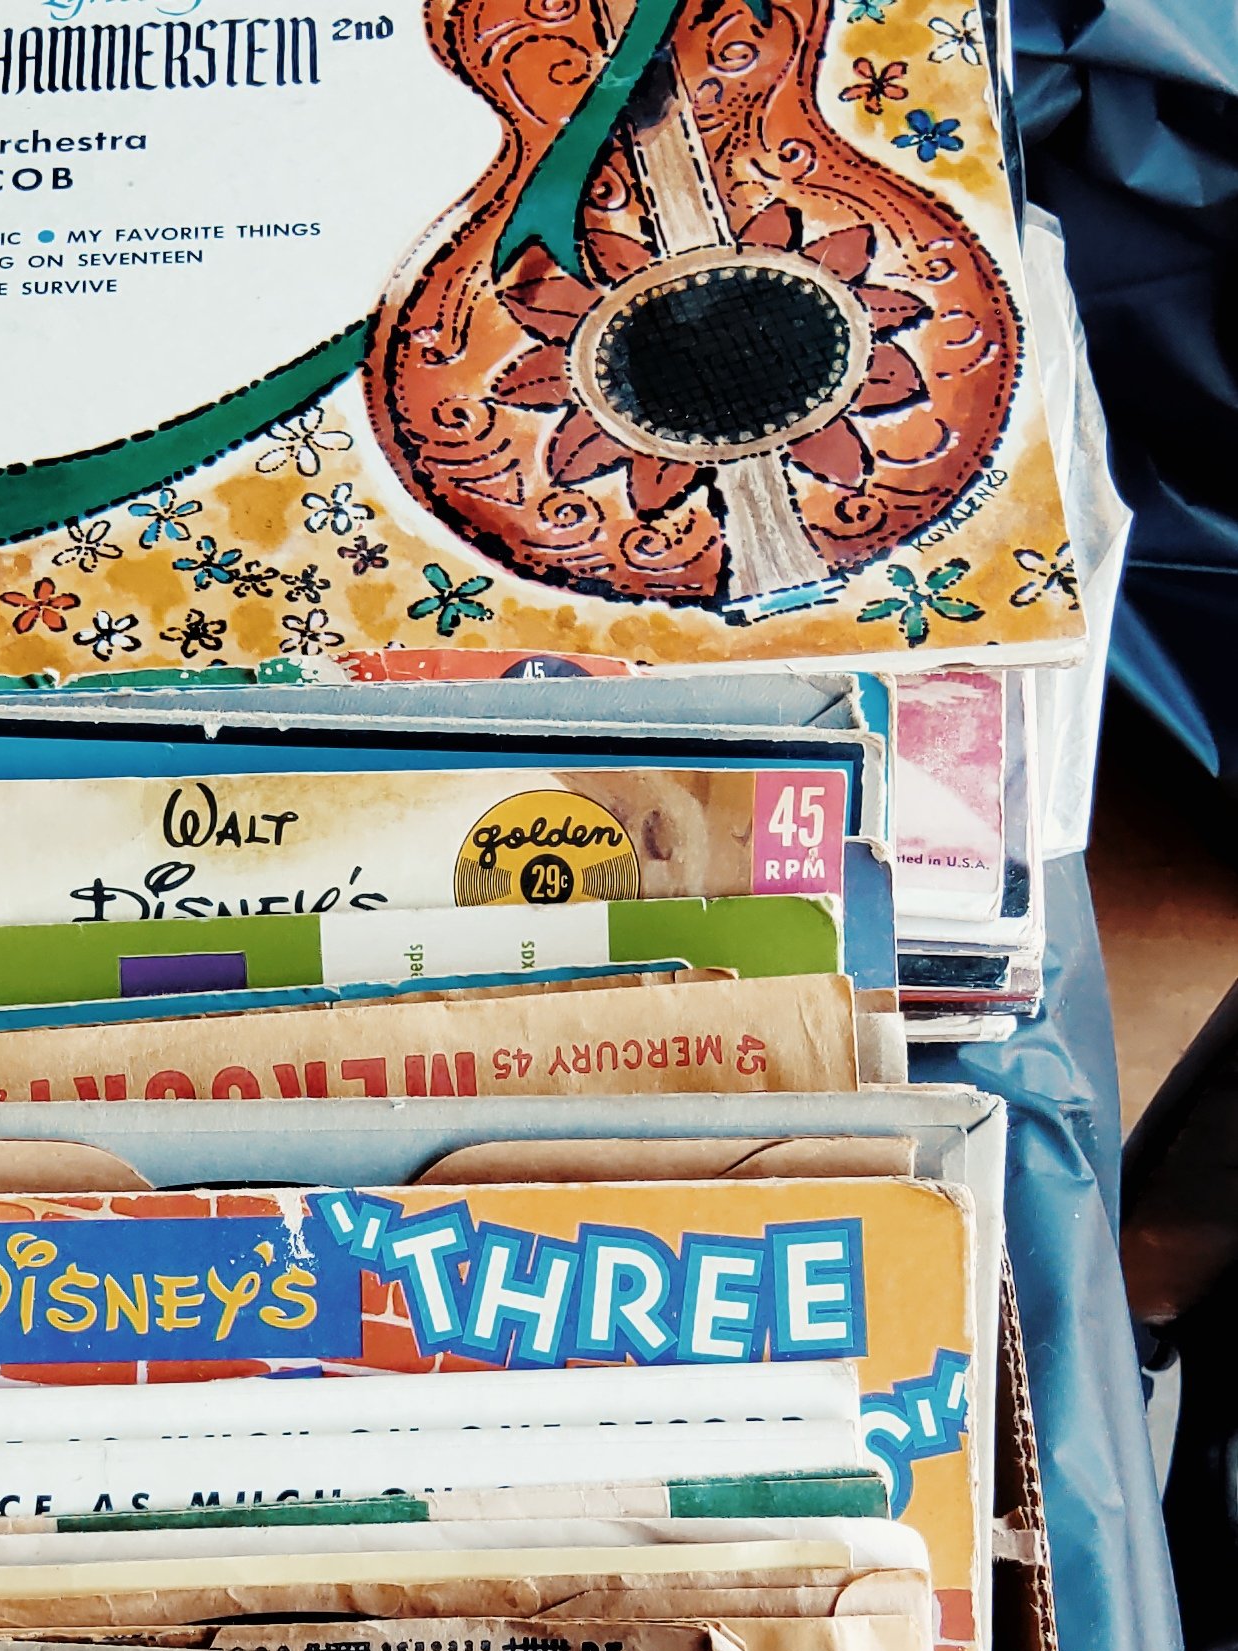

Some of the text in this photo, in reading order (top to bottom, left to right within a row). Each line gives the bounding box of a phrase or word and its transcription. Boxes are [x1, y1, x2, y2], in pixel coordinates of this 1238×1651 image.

[331, 15, 394, 42] 2nd
[67, 230, 102, 243] MY
[116, 226, 223, 242] FAVORITE
[237, 223, 320, 238] THINGS
[28, 255, 63, 268] ON
[78, 250, 202, 266] SEVENTEEN
[22, 279, 117, 295] SURVIVE
[768, 785, 825, 848] 45
[473, 816, 623, 869] golden
[765, 858, 826, 881] RPM
[946, 856, 990, 870] U.S.A.
[493, 1048, 532, 1079] 45
[549, 1035, 723, 1076] MERCURY
[736, 1034, 767, 1074] 45
